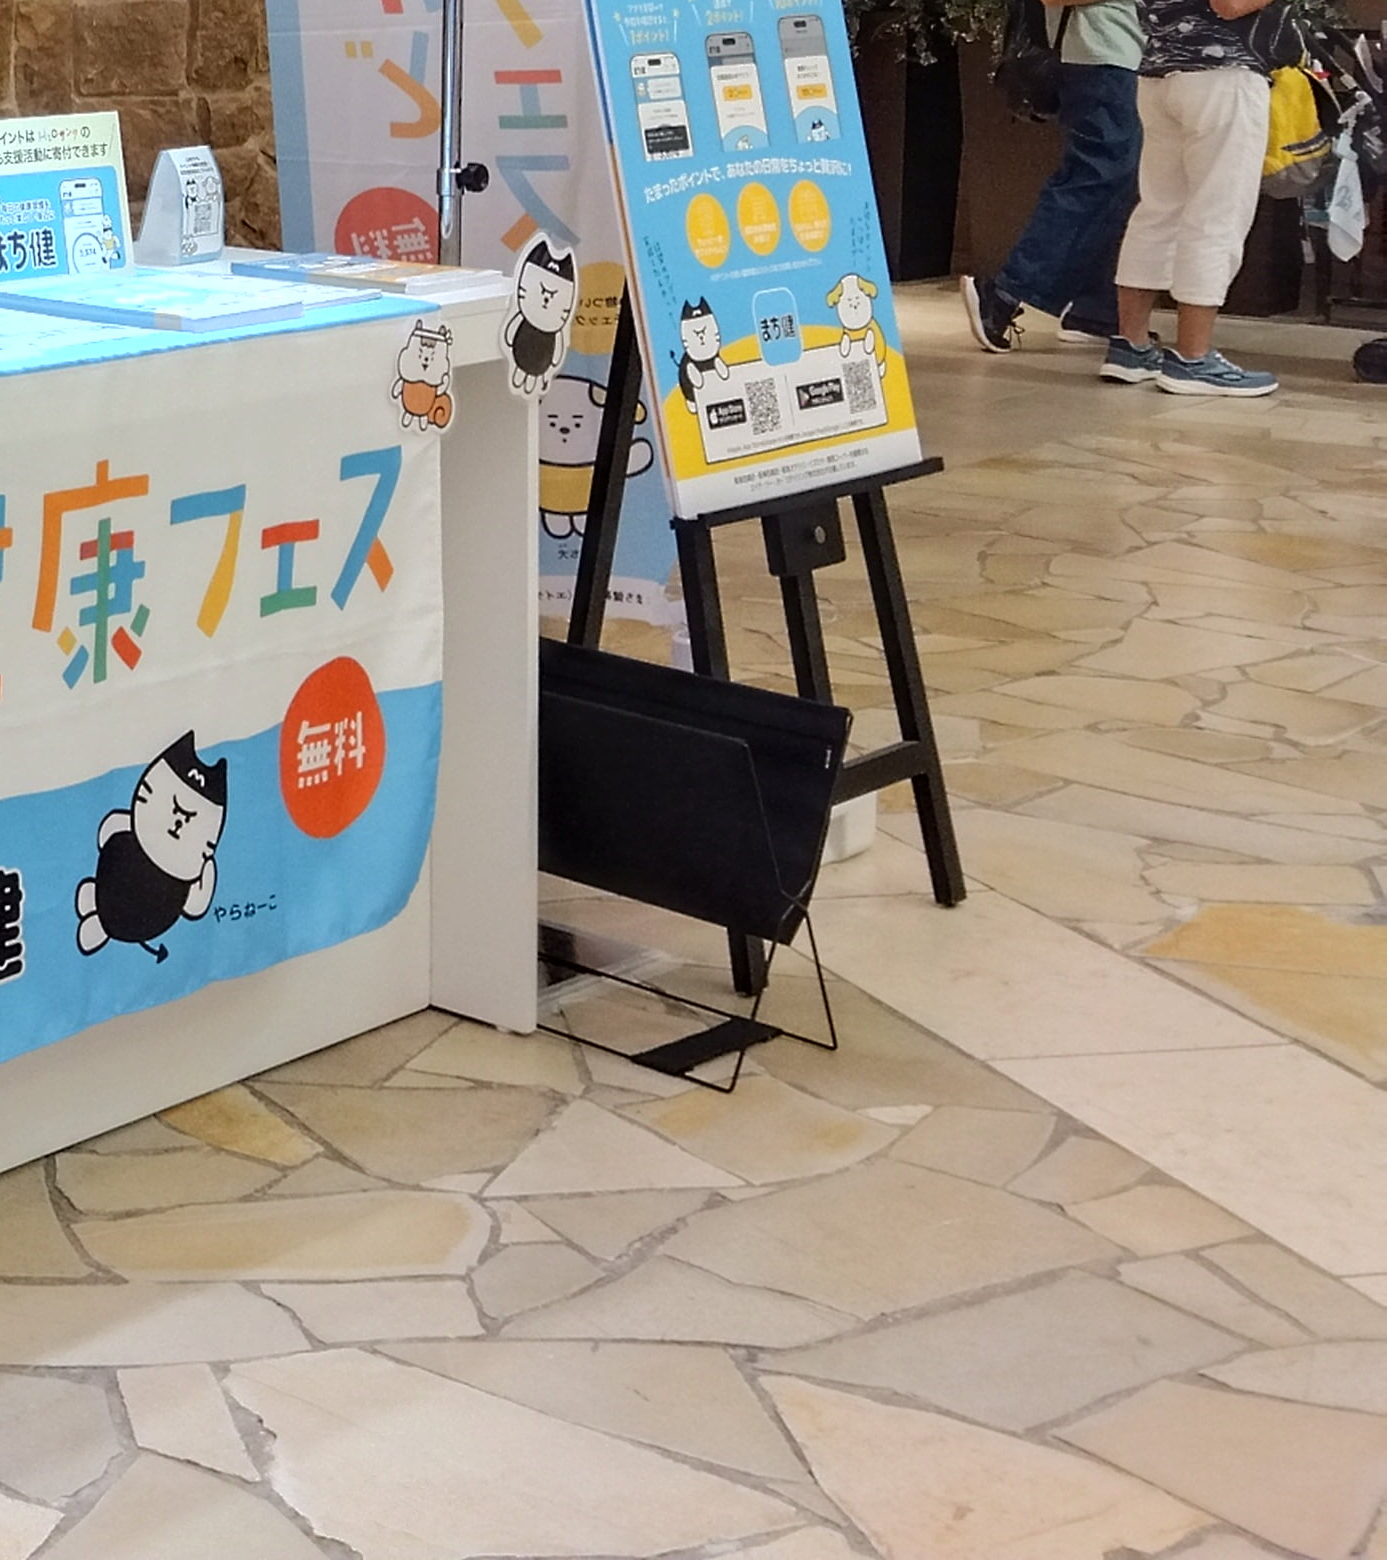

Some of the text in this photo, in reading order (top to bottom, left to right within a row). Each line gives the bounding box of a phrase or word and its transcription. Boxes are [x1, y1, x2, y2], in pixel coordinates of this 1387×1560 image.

[760, 314, 797, 343] まち健
[297, 711, 366, 789] 無料
